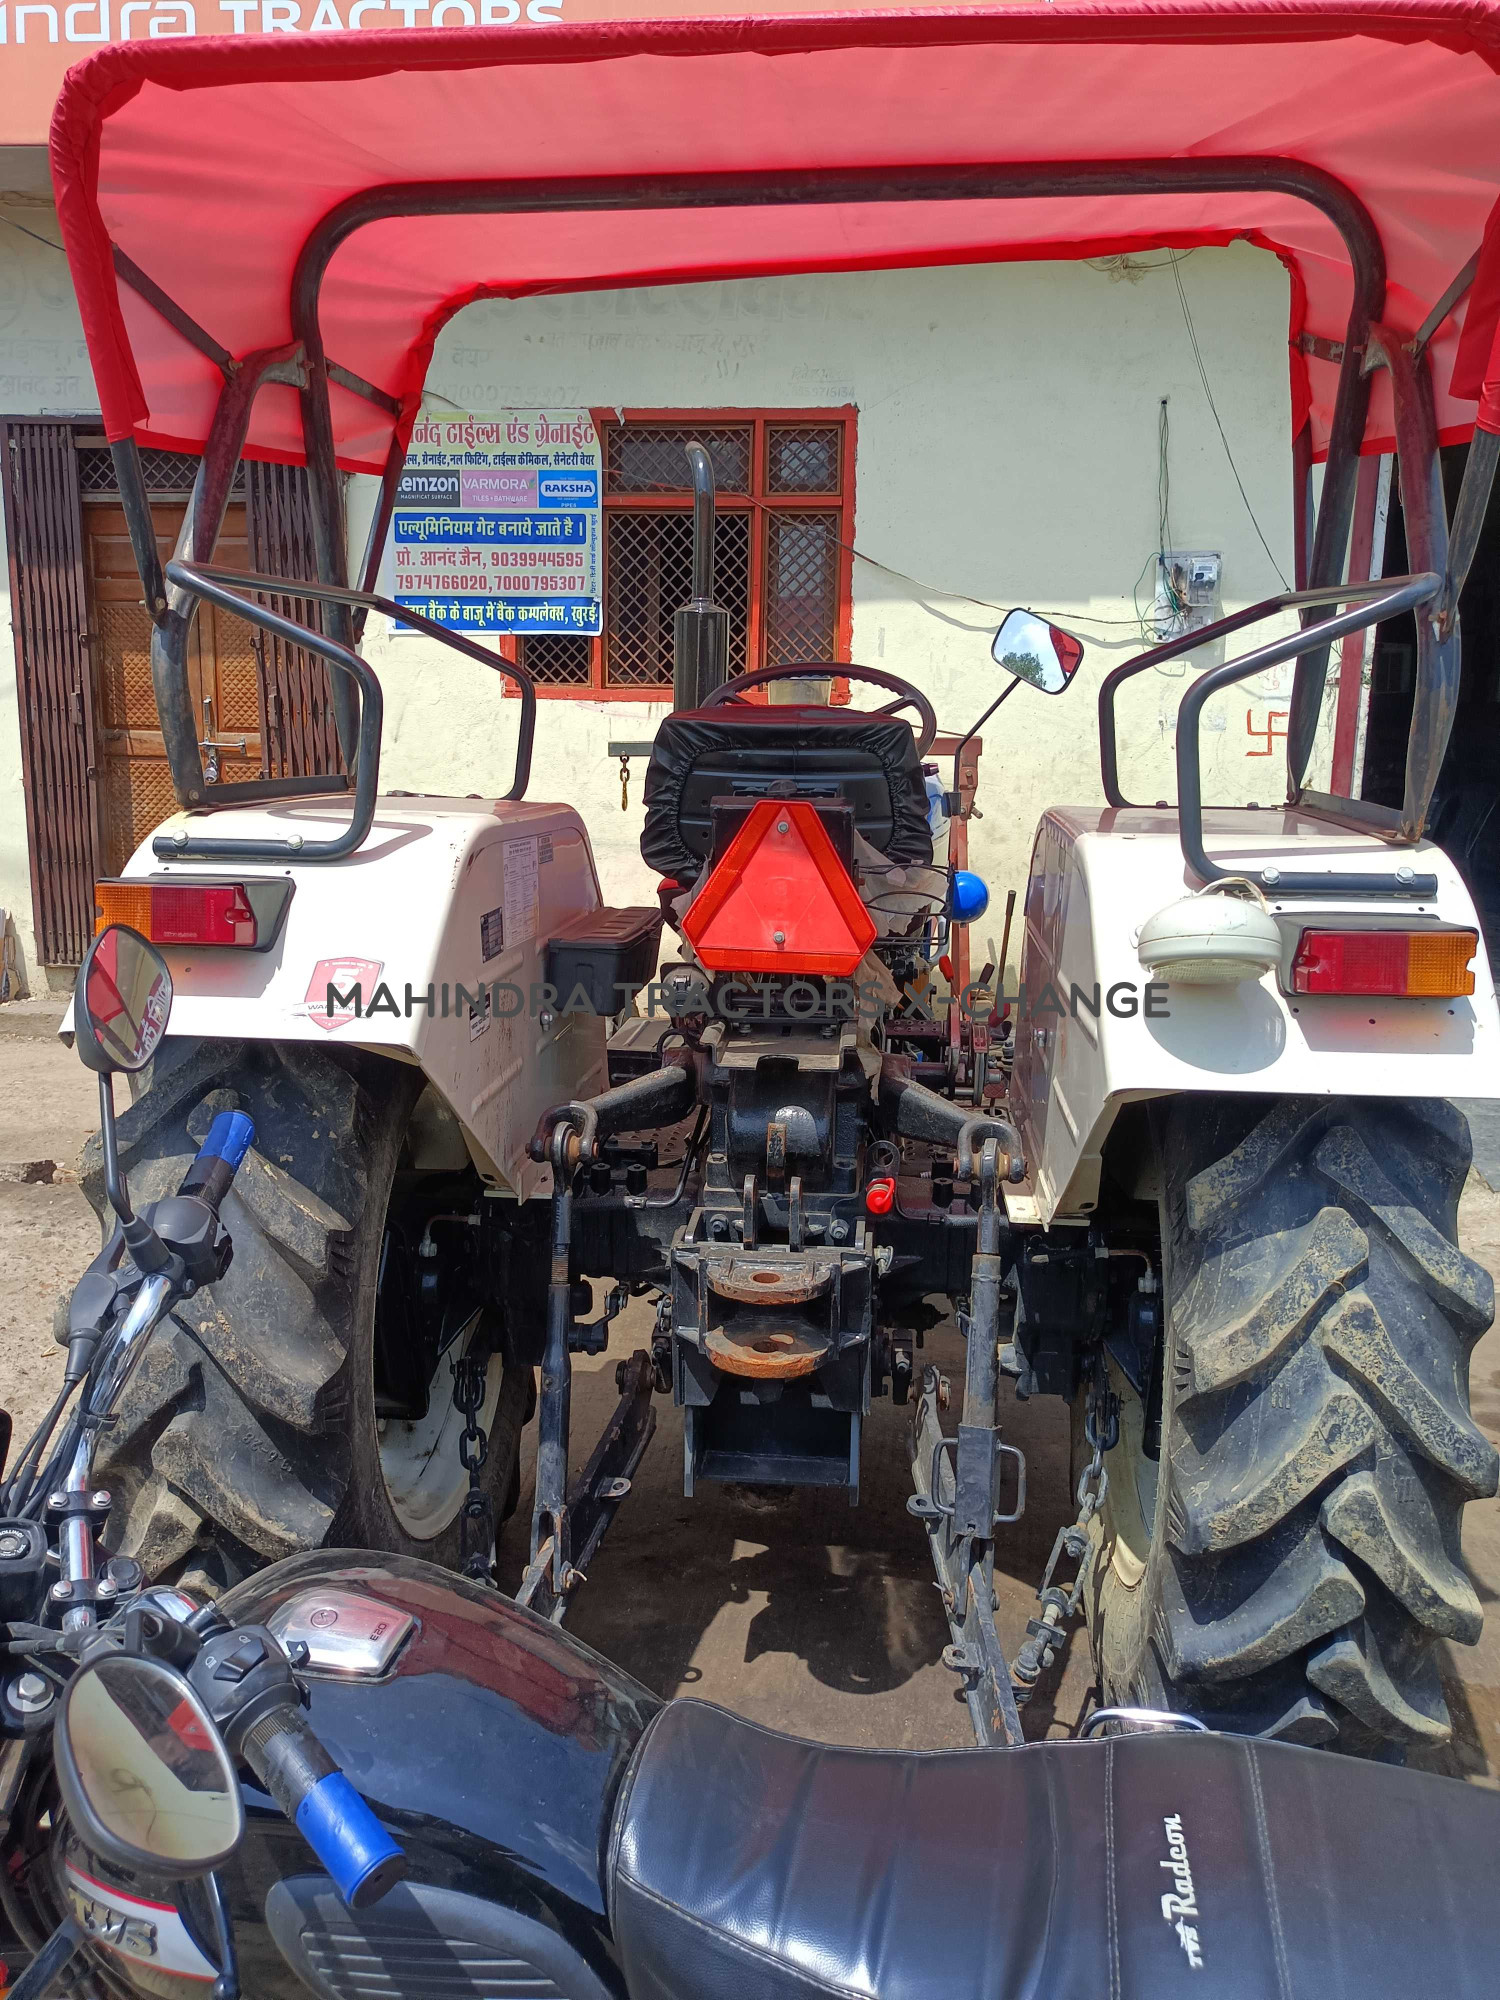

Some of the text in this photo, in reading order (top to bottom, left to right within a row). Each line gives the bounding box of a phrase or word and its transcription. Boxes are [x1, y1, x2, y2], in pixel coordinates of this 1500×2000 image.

[410, 414, 595, 449] नंद टाईल्स एंड ग्रेनाईट
[492, 451, 516, 466] टाईल्स
[518, 452, 551, 467] केमिकल,
[553, 452, 578, 465] सेनेटरी
[579, 452, 595, 465] वेयर
[462, 478, 528, 490] VARMORA
[545, 484, 593, 493] RAKSHA
[472, 494, 528, 503] TILES BATHWARE
[398, 516, 474, 541] एल्यूमिनियम
[476, 516, 496, 536] गेट
[498, 517, 533, 536] बनाये
[534, 517, 561, 537] जाते
[420, 547, 457, 567] आनंद
[458, 546, 487, 570] जैन,
[491, 551, 584, 567] 9039944595
[428, 599, 447, 621] बैंक
[449, 601, 461, 621] के
[461, 601, 485, 627] बाजू
[485, 601, 496, 621] में
[496, 600, 516, 622] बैंक
[369, 1622, 388, 1641] E20
[1159, 1813, 1199, 1920] Radeon
